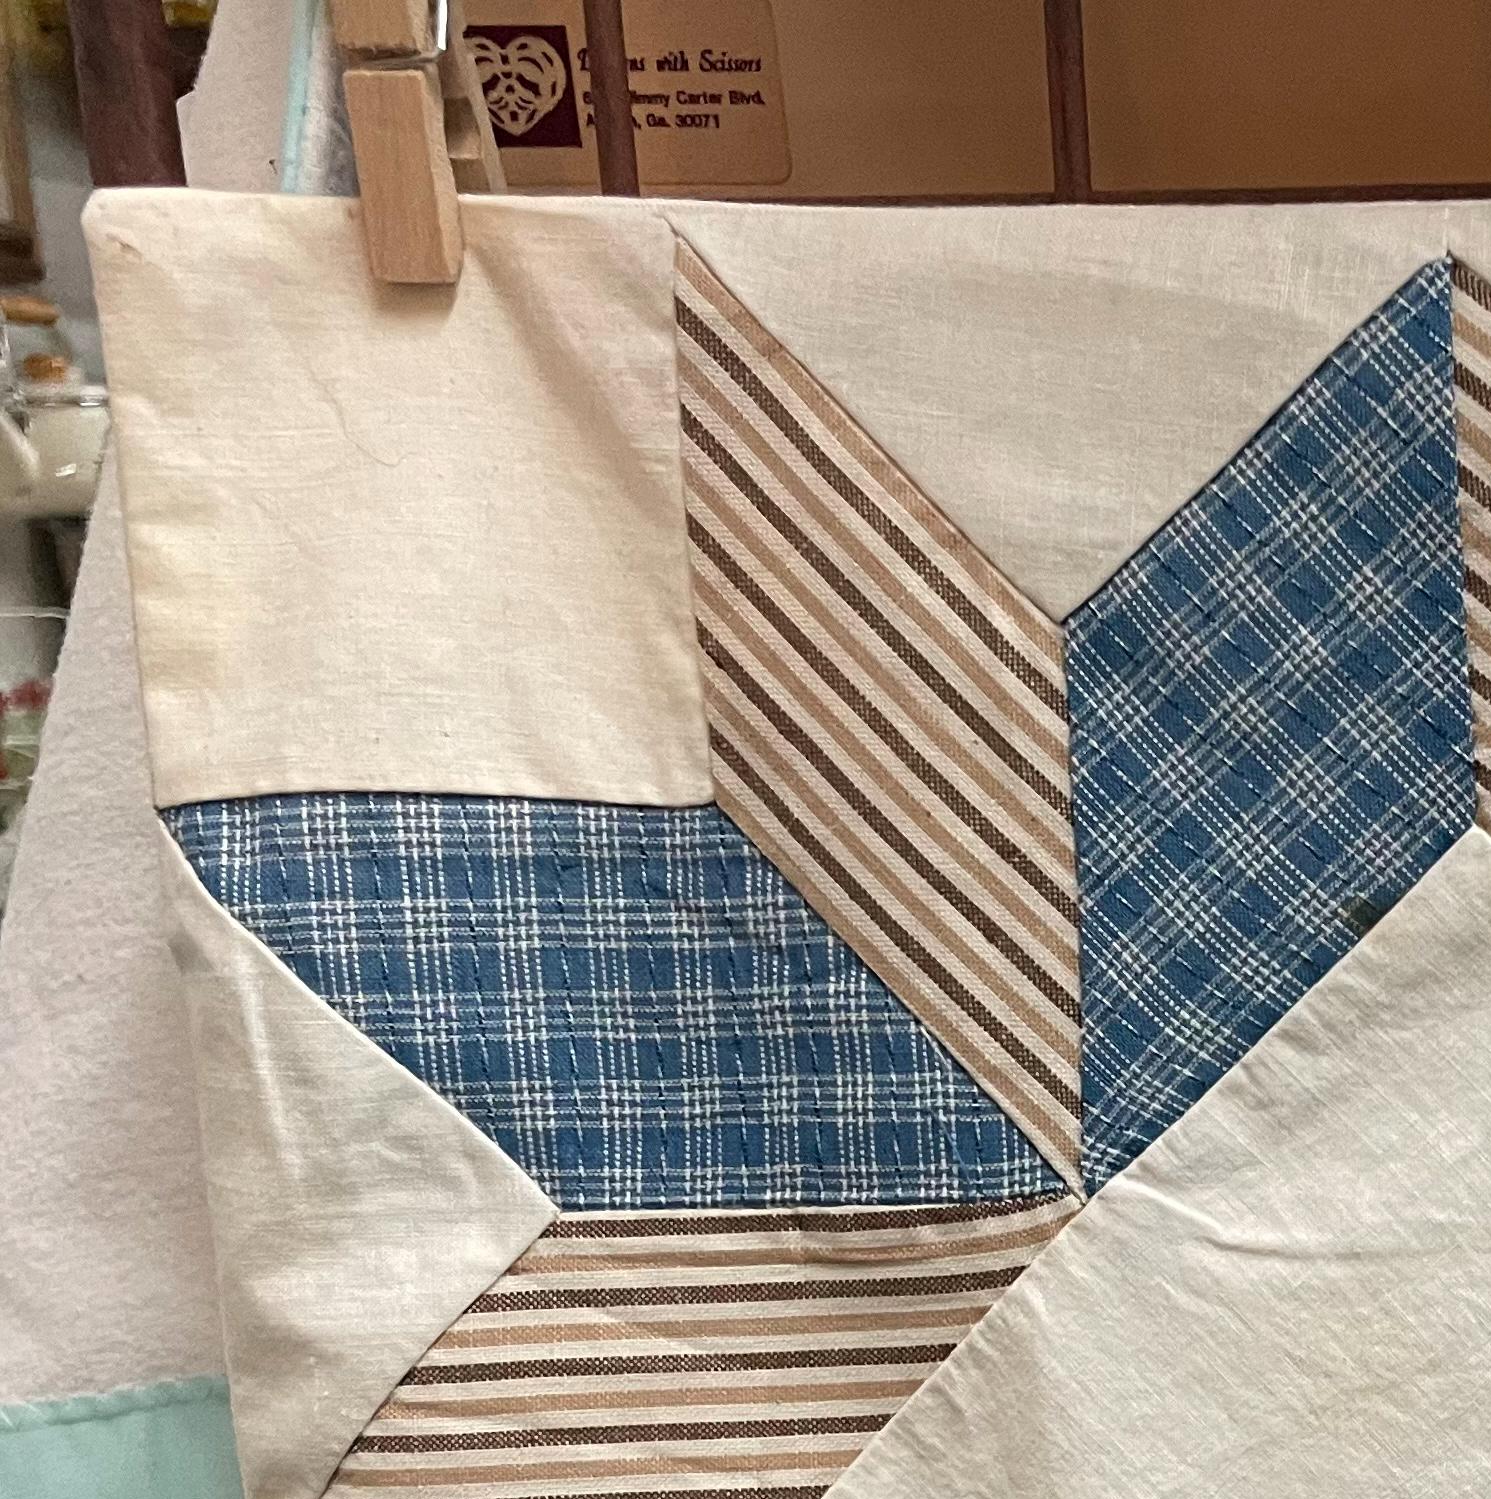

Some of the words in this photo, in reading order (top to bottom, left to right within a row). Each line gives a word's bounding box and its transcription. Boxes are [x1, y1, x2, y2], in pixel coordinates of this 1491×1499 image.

[656, 50, 689, 71] with
[699, 49, 762, 72] Scissors
[676, 91, 723, 105] Carter
[729, 90, 766, 105] Blvd.
[675, 114, 720, 128] 30071
